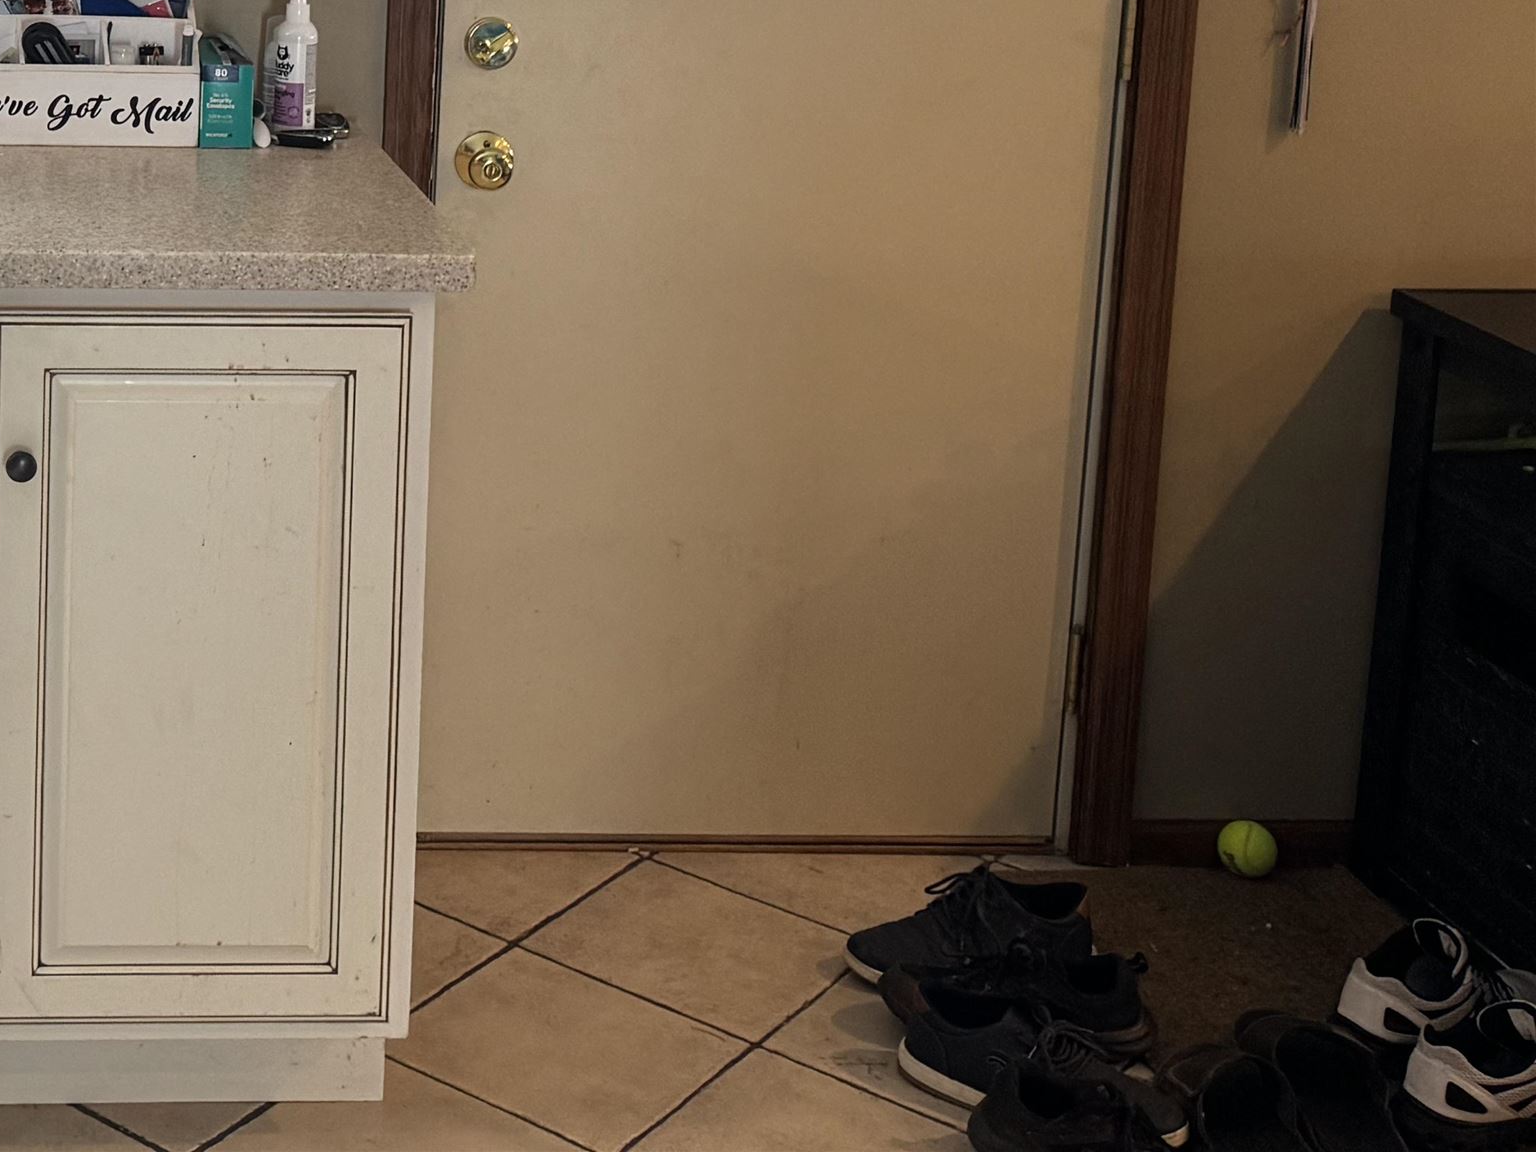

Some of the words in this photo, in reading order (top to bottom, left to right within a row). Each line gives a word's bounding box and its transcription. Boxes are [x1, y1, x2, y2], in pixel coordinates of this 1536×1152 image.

[214, 68, 228, 77] 80
[47, 94, 112, 131] Got
[110, 96, 194, 135] Mail
